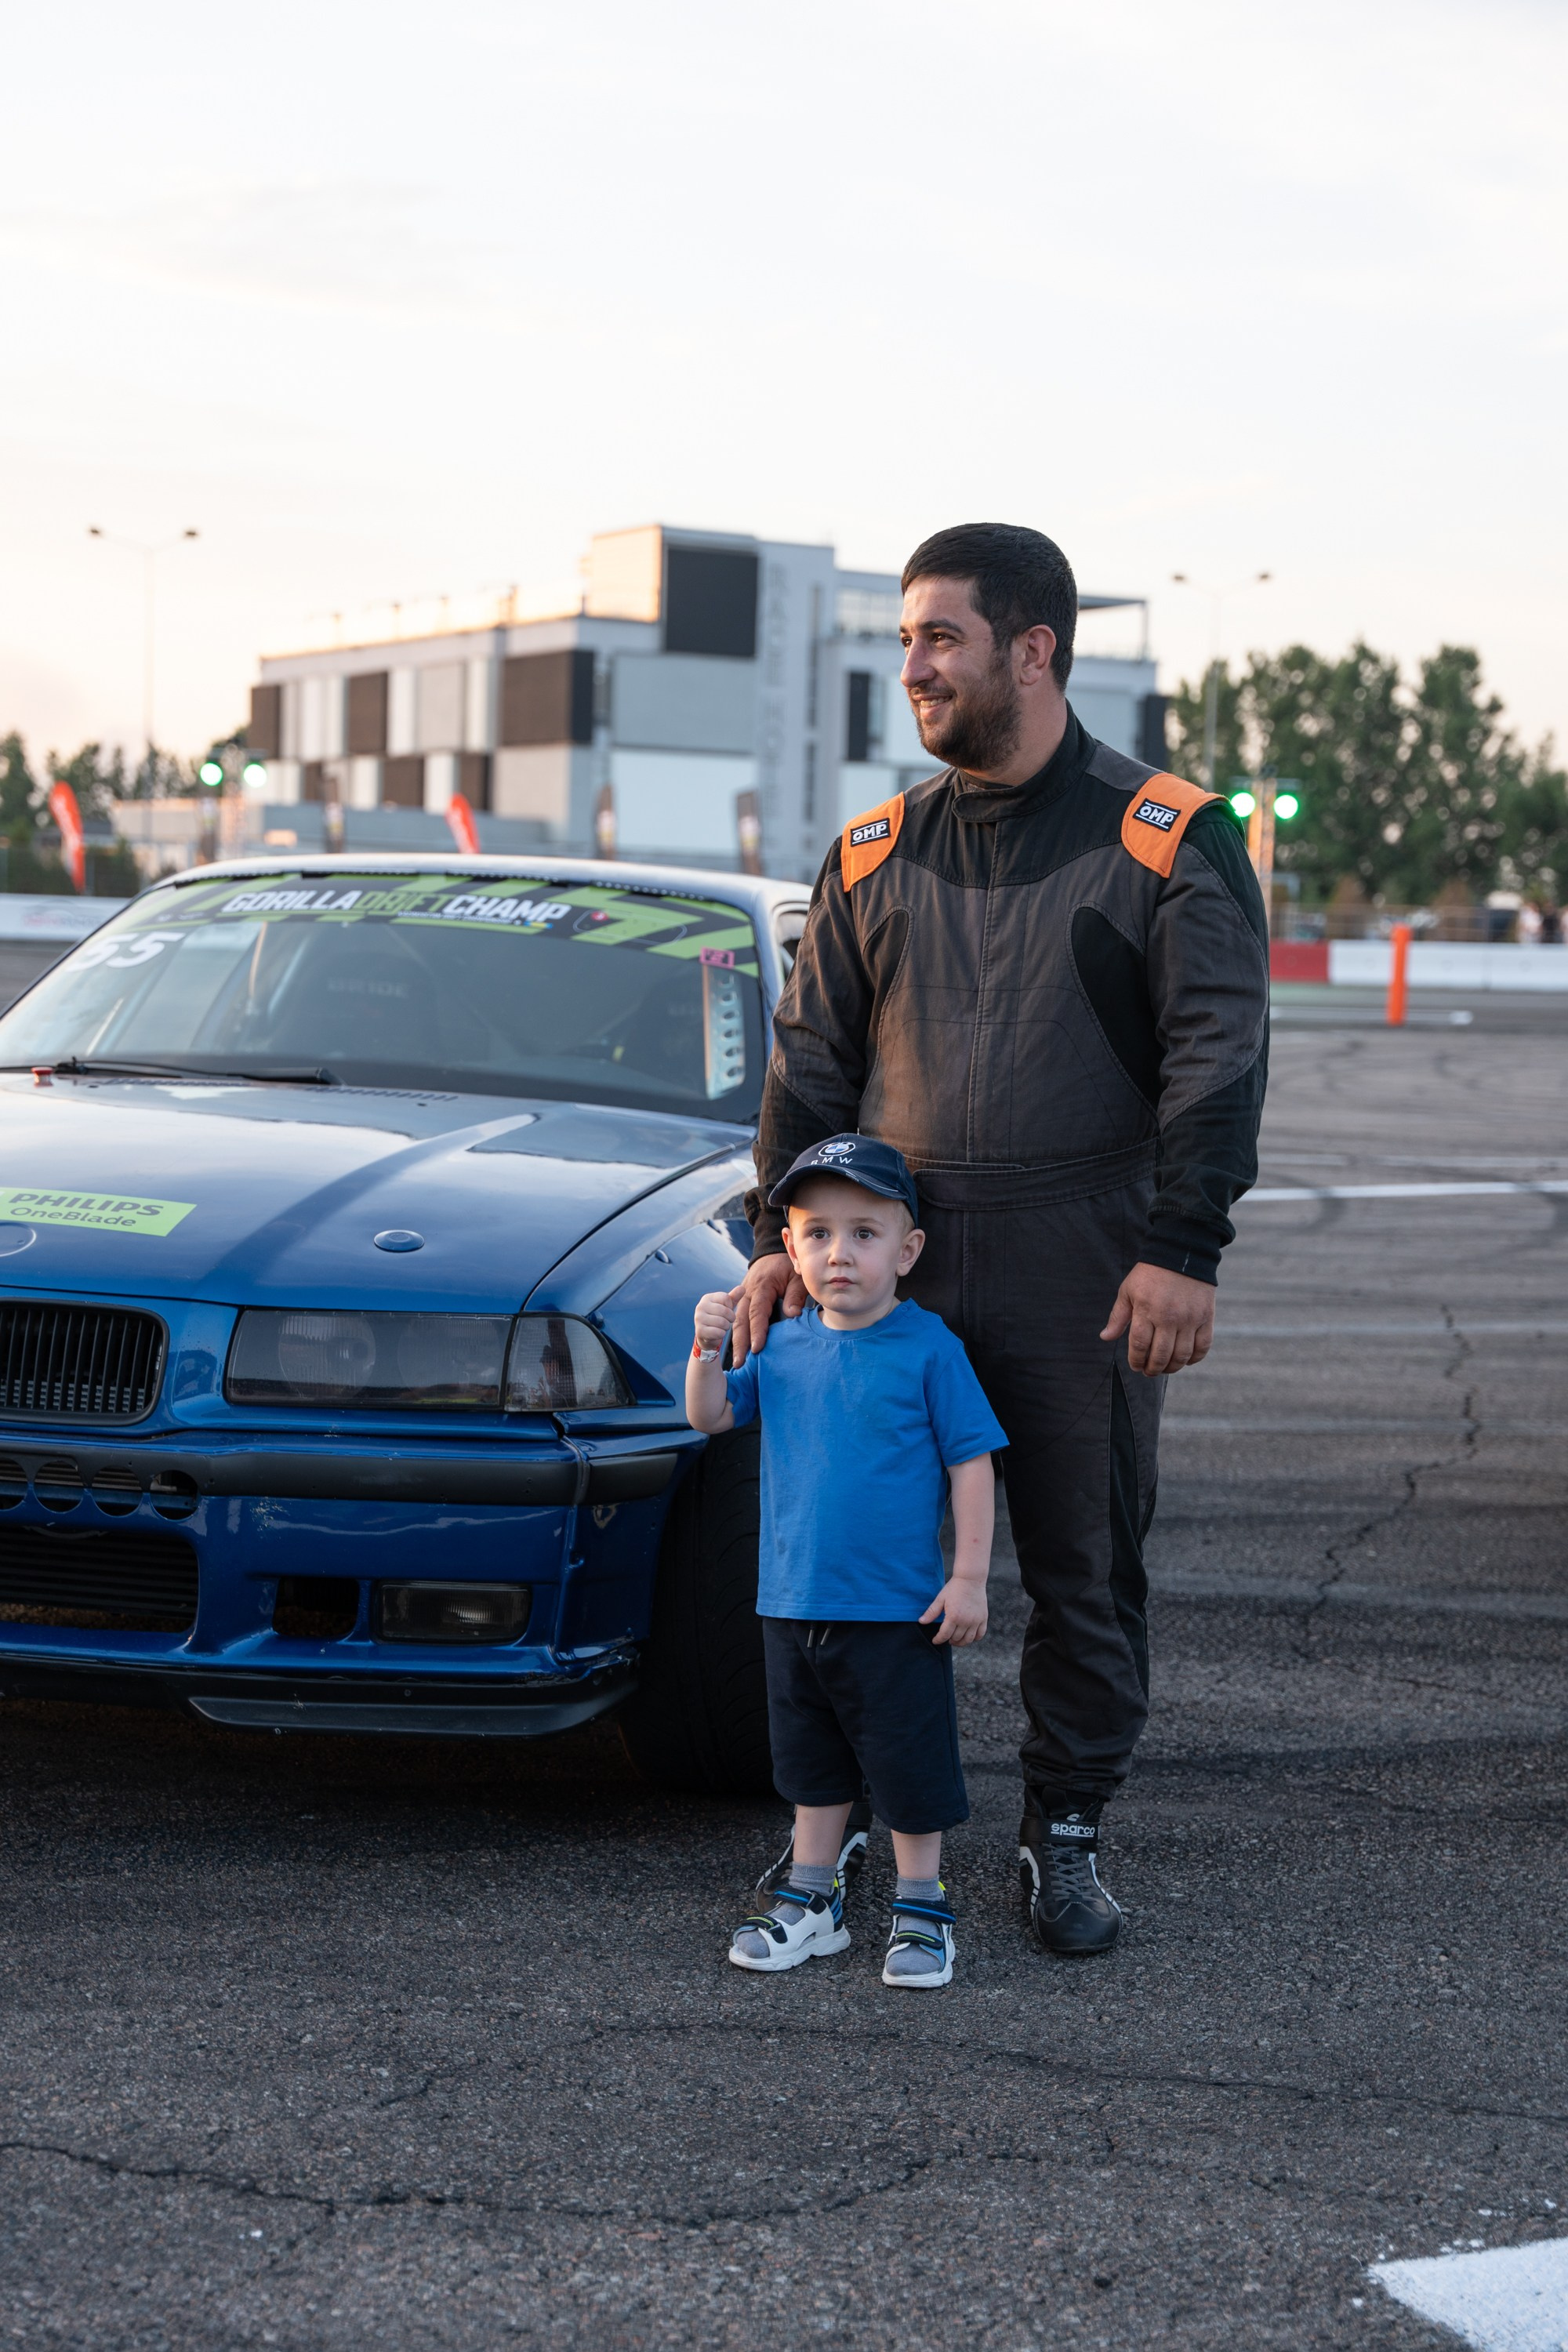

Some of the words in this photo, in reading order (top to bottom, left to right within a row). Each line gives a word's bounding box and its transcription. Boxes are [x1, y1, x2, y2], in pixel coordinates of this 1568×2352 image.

[1139, 805, 1174, 824] OMP
[852, 823, 887, 841] OMP
[65, 931, 187, 973] 55
[810, 1155, 853, 1166] BMW
[8, 1192, 165, 1216] PHILIPS
[9, 1207, 136, 1227] OneBlade
[1051, 1823, 1095, 1836] sparco
